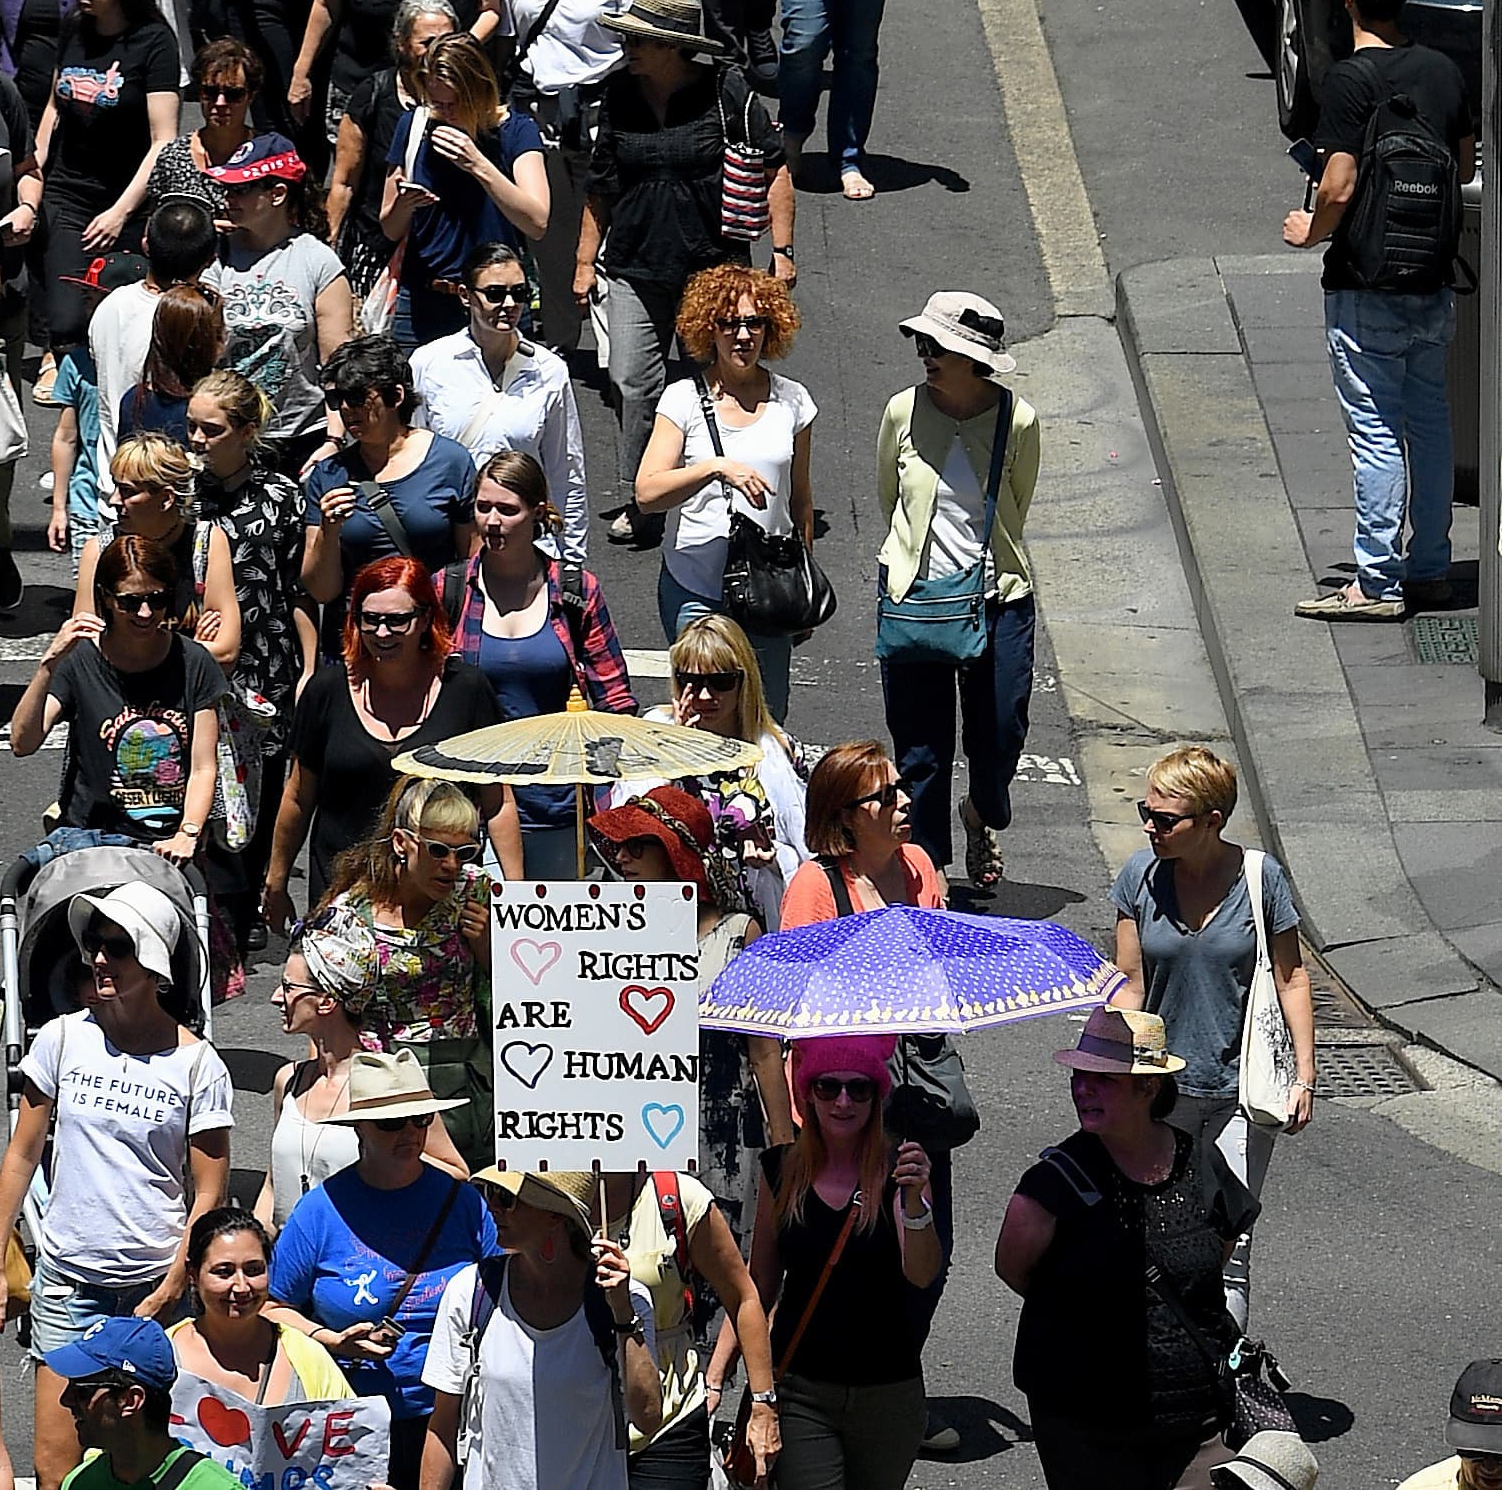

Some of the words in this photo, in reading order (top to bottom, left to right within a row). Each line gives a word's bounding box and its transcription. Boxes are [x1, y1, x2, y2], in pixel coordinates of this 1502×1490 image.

[242, 159, 285, 180] PARIS
[1394, 179, 1439, 196] Reebok
[492, 902, 646, 933] WOMEN'S
[576, 949, 700, 983] RIGHTS
[495, 999, 572, 1032] ARE
[561, 1050, 700, 1085] HUMAN
[70, 1070, 104, 1089] THE
[109, 1078, 180, 1107] FUTURE
[72, 1092, 88, 1106] IS
[93, 1096, 166, 1123] FEMALE
[497, 1110, 625, 1143] RIGHTS
